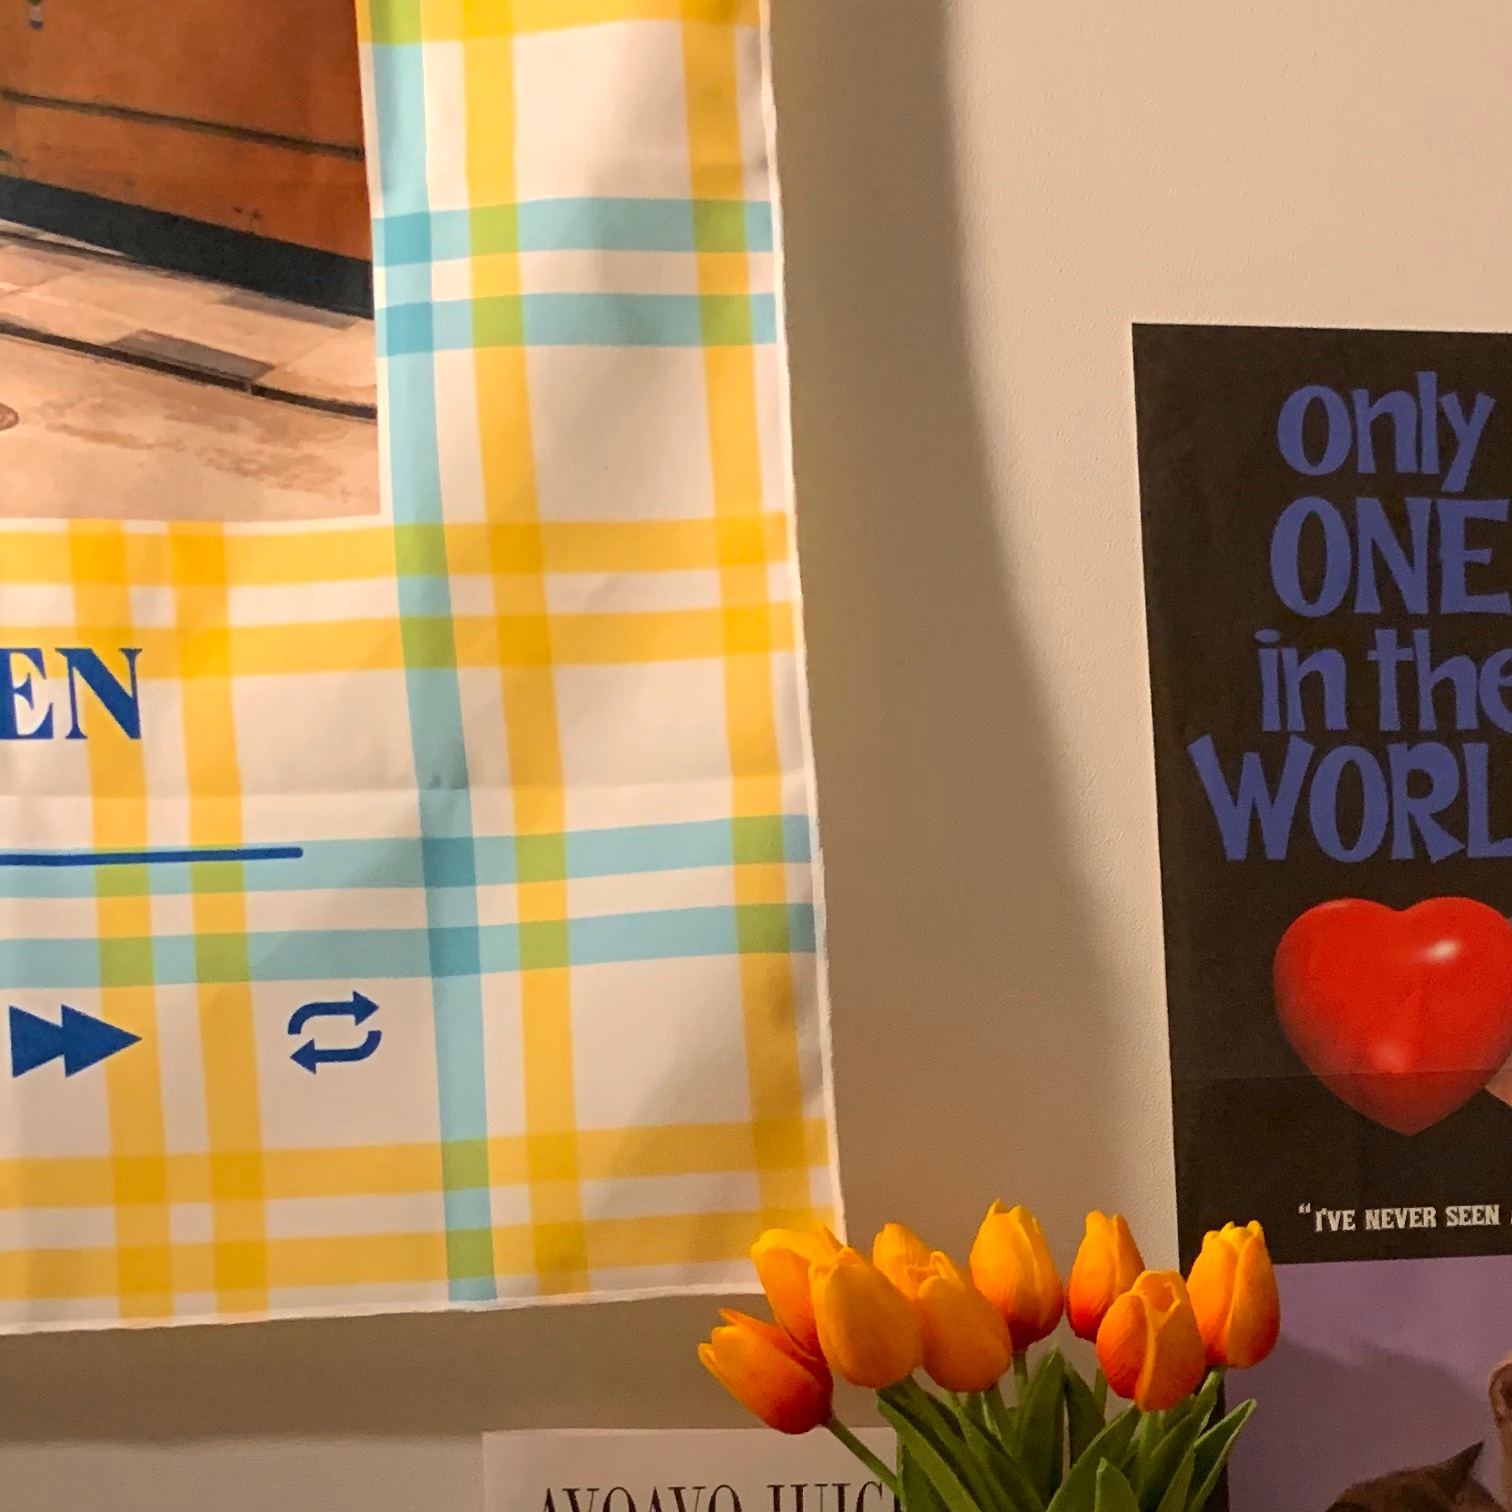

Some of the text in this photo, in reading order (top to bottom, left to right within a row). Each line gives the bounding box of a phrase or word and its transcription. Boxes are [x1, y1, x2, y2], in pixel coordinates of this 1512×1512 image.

[1270, 496, 1512, 617] ONE
[1253, 628, 1349, 733] in
[1365, 1207, 1437, 1230] NEVER
[1446, 1204, 1500, 1228] SEEN
